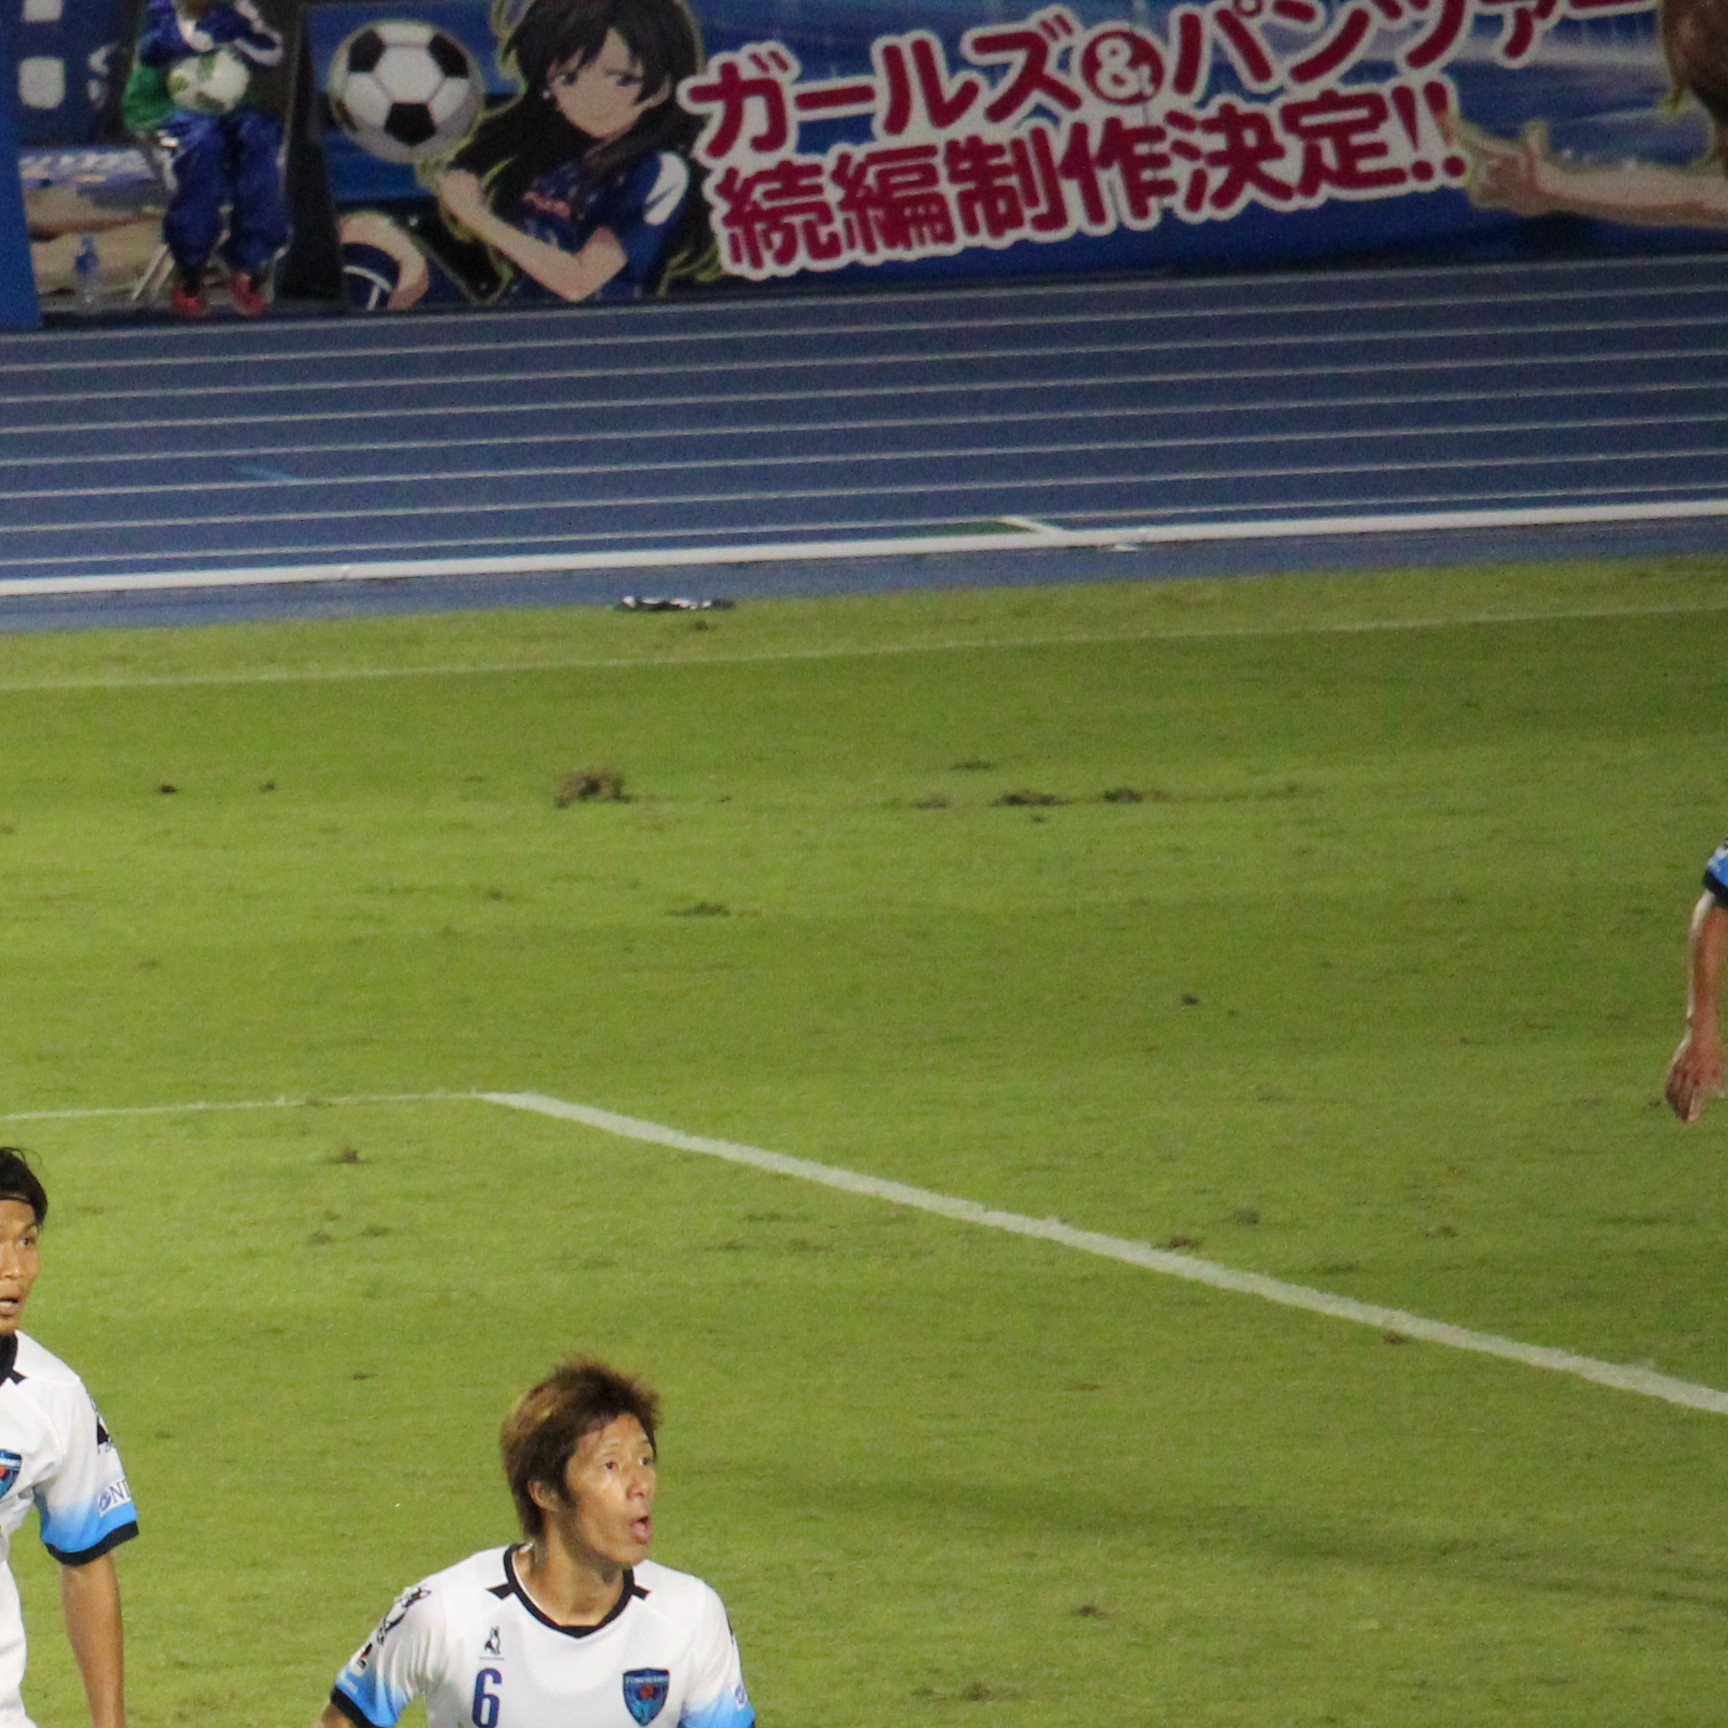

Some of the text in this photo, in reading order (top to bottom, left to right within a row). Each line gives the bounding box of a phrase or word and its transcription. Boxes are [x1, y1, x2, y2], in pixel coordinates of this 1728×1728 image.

[720, 79, 1467, 271] 続編制作決定!!
